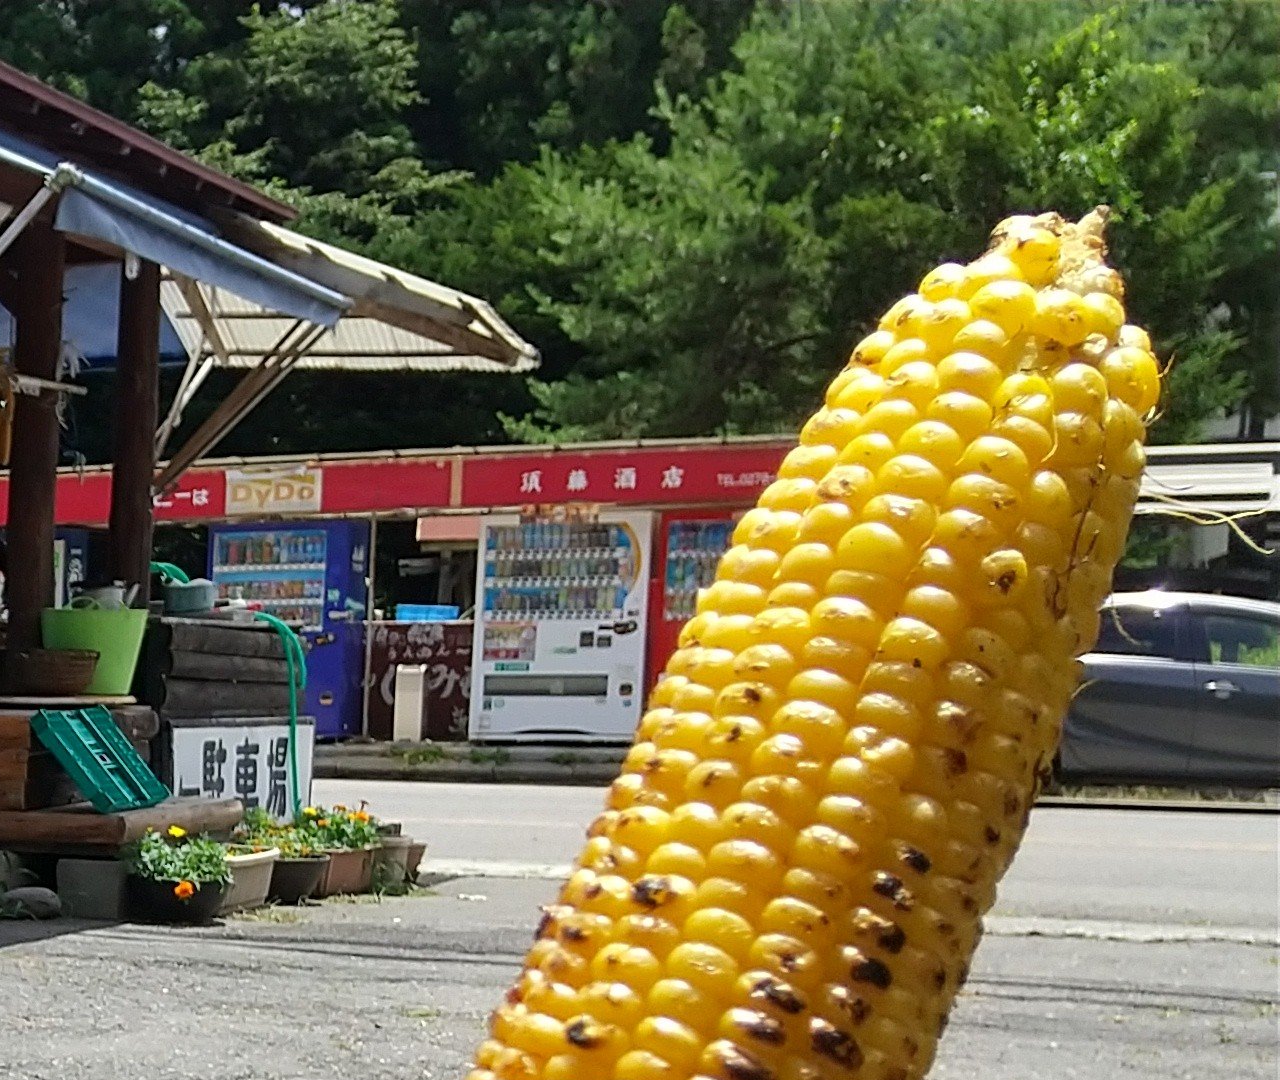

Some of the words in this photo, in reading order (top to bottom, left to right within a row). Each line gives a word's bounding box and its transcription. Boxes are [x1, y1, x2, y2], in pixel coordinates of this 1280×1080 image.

[231, 481, 315, 508] DyDo
[202, 735, 289, 818] 駐車場
